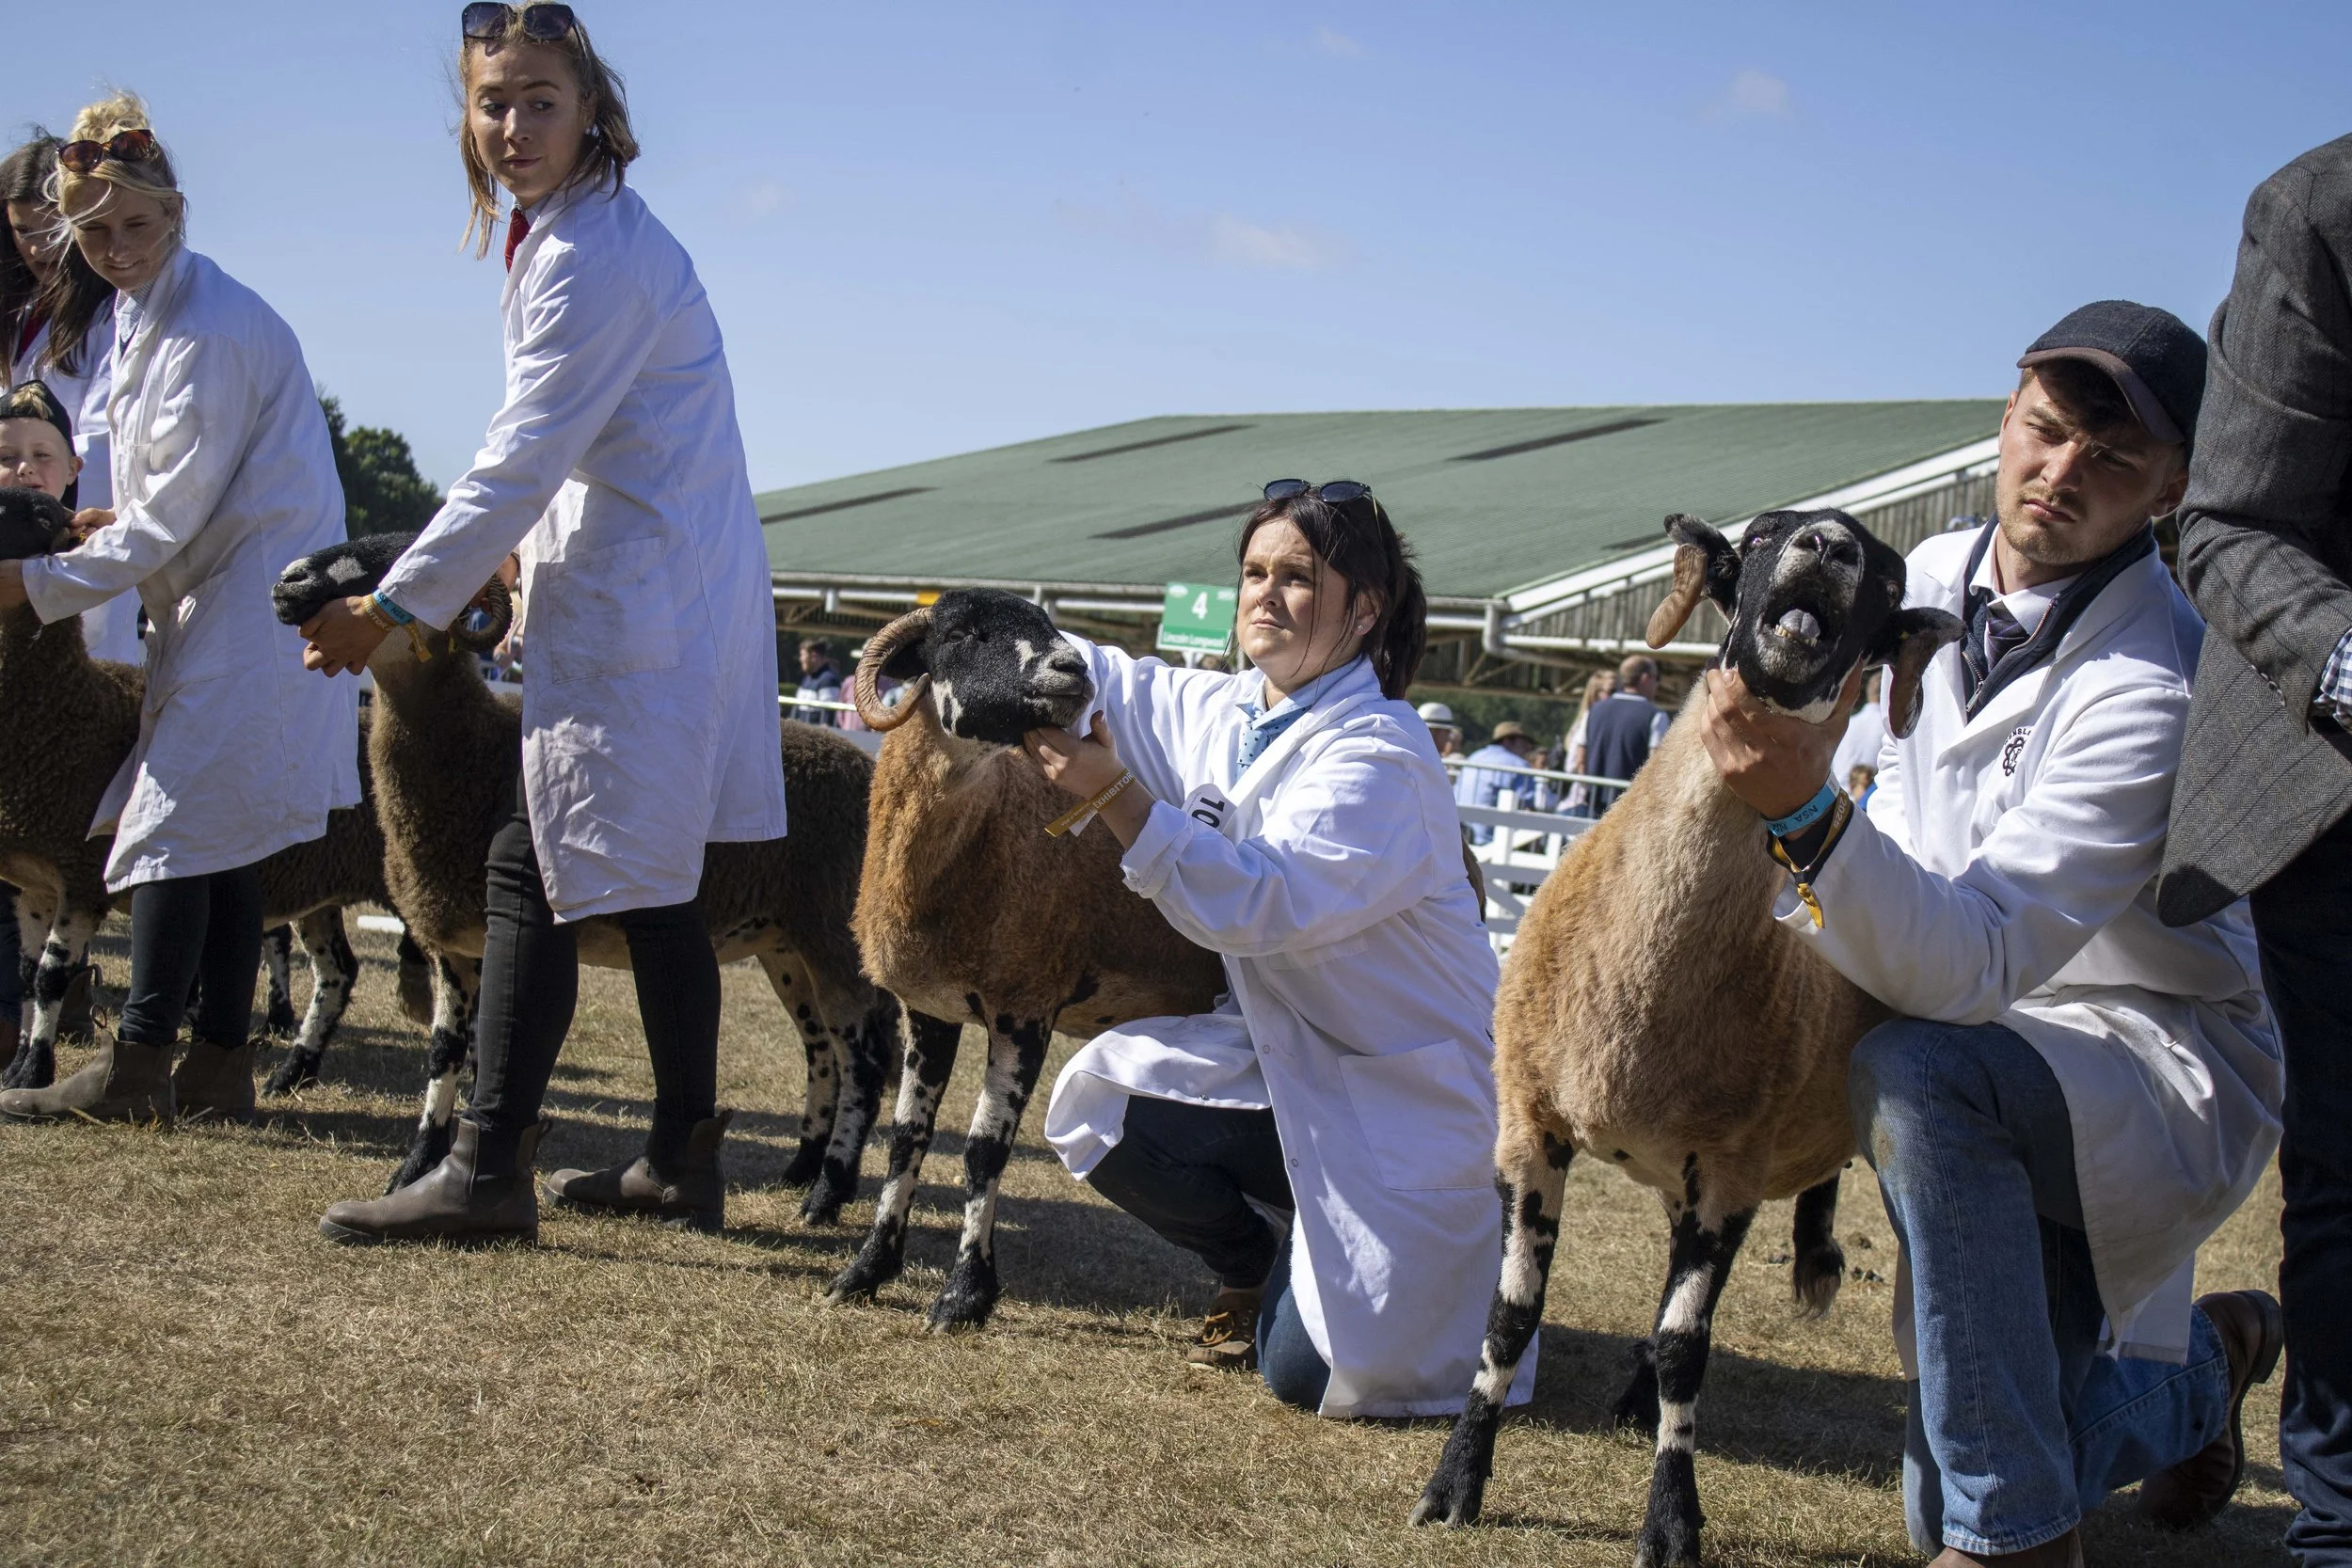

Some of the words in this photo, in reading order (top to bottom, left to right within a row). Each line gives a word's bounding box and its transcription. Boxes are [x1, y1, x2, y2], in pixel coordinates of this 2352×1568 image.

[1191, 592, 1208, 620] 4
[1093, 772, 1133, 809] EXHIBITOR
[1793, 804, 1819, 823] NSA
[1833, 796, 1848, 830] 2025
